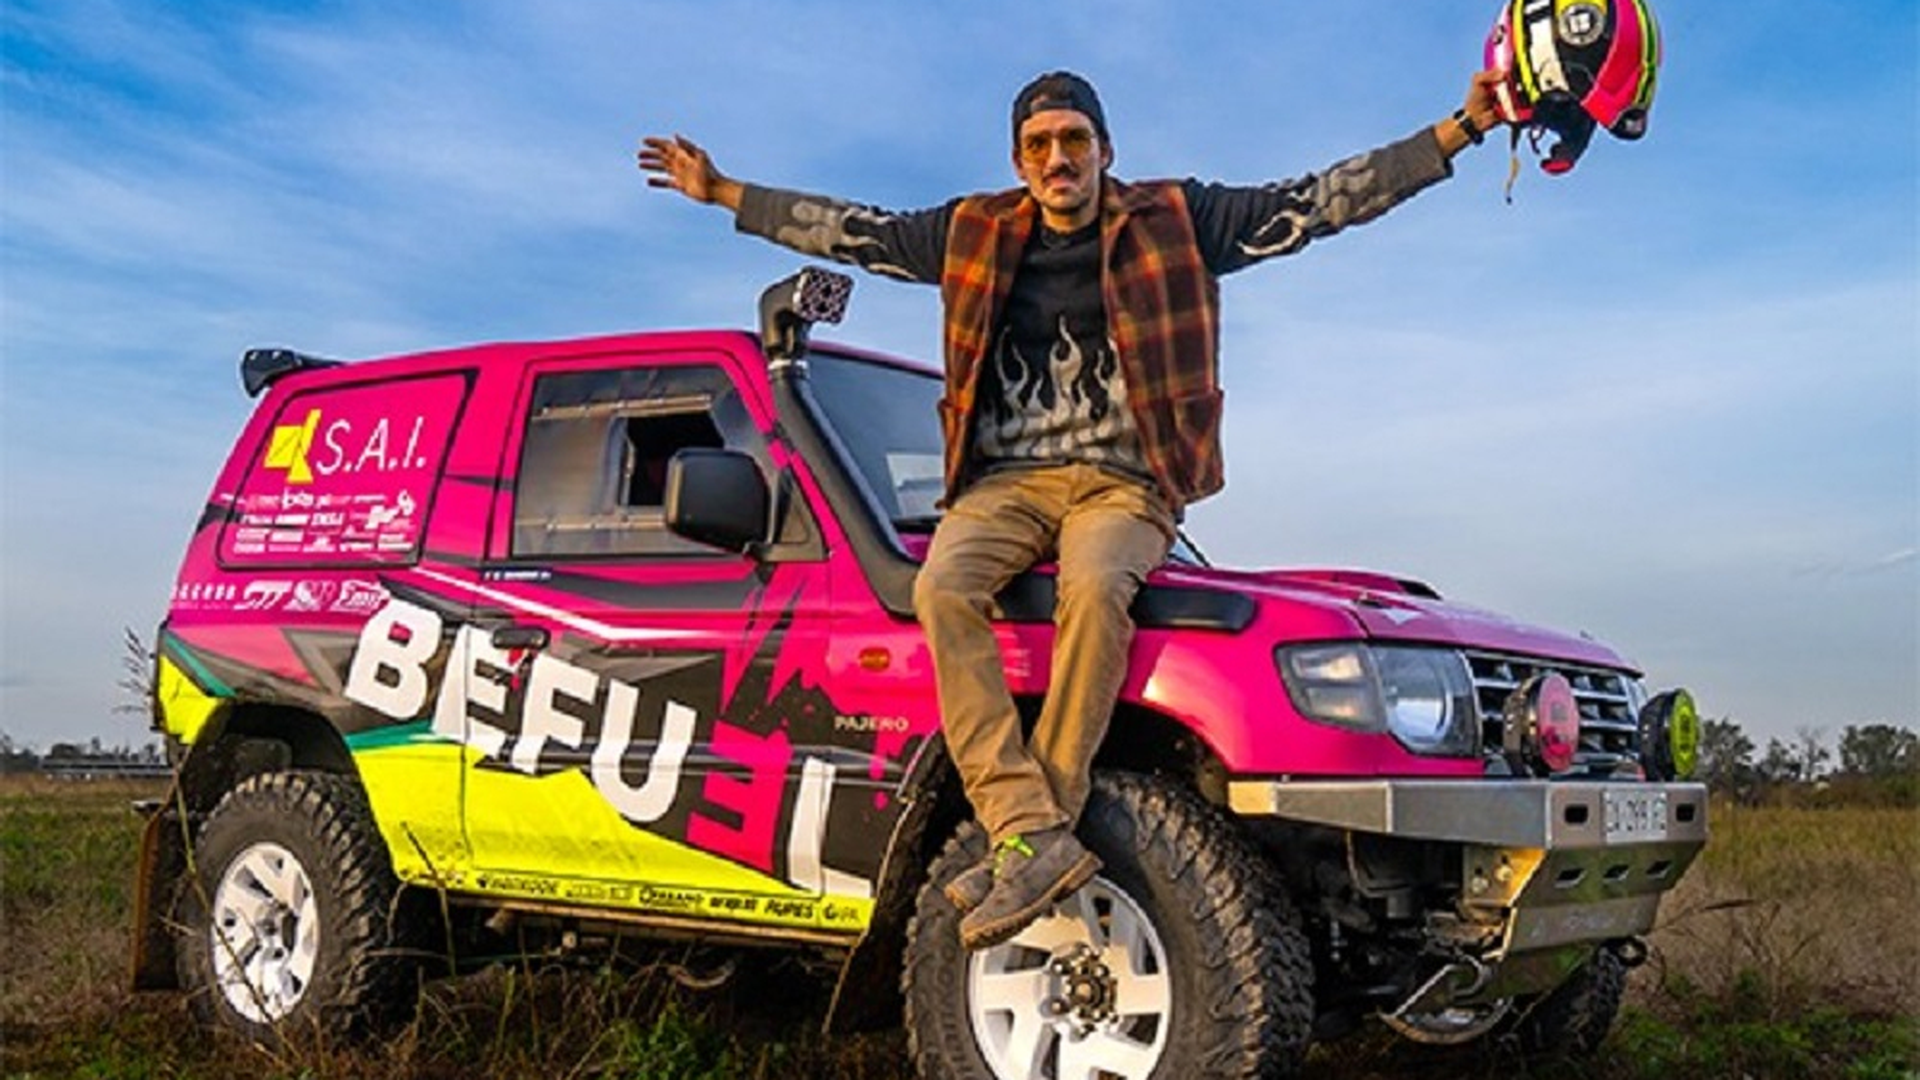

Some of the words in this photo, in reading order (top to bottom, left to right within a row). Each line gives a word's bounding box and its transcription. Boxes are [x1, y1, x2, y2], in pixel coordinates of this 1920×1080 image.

[316, 416, 427, 475] S.A.I.
[344, 598, 872, 899] BEFUEL
[834, 715, 909, 733] PAJERO
